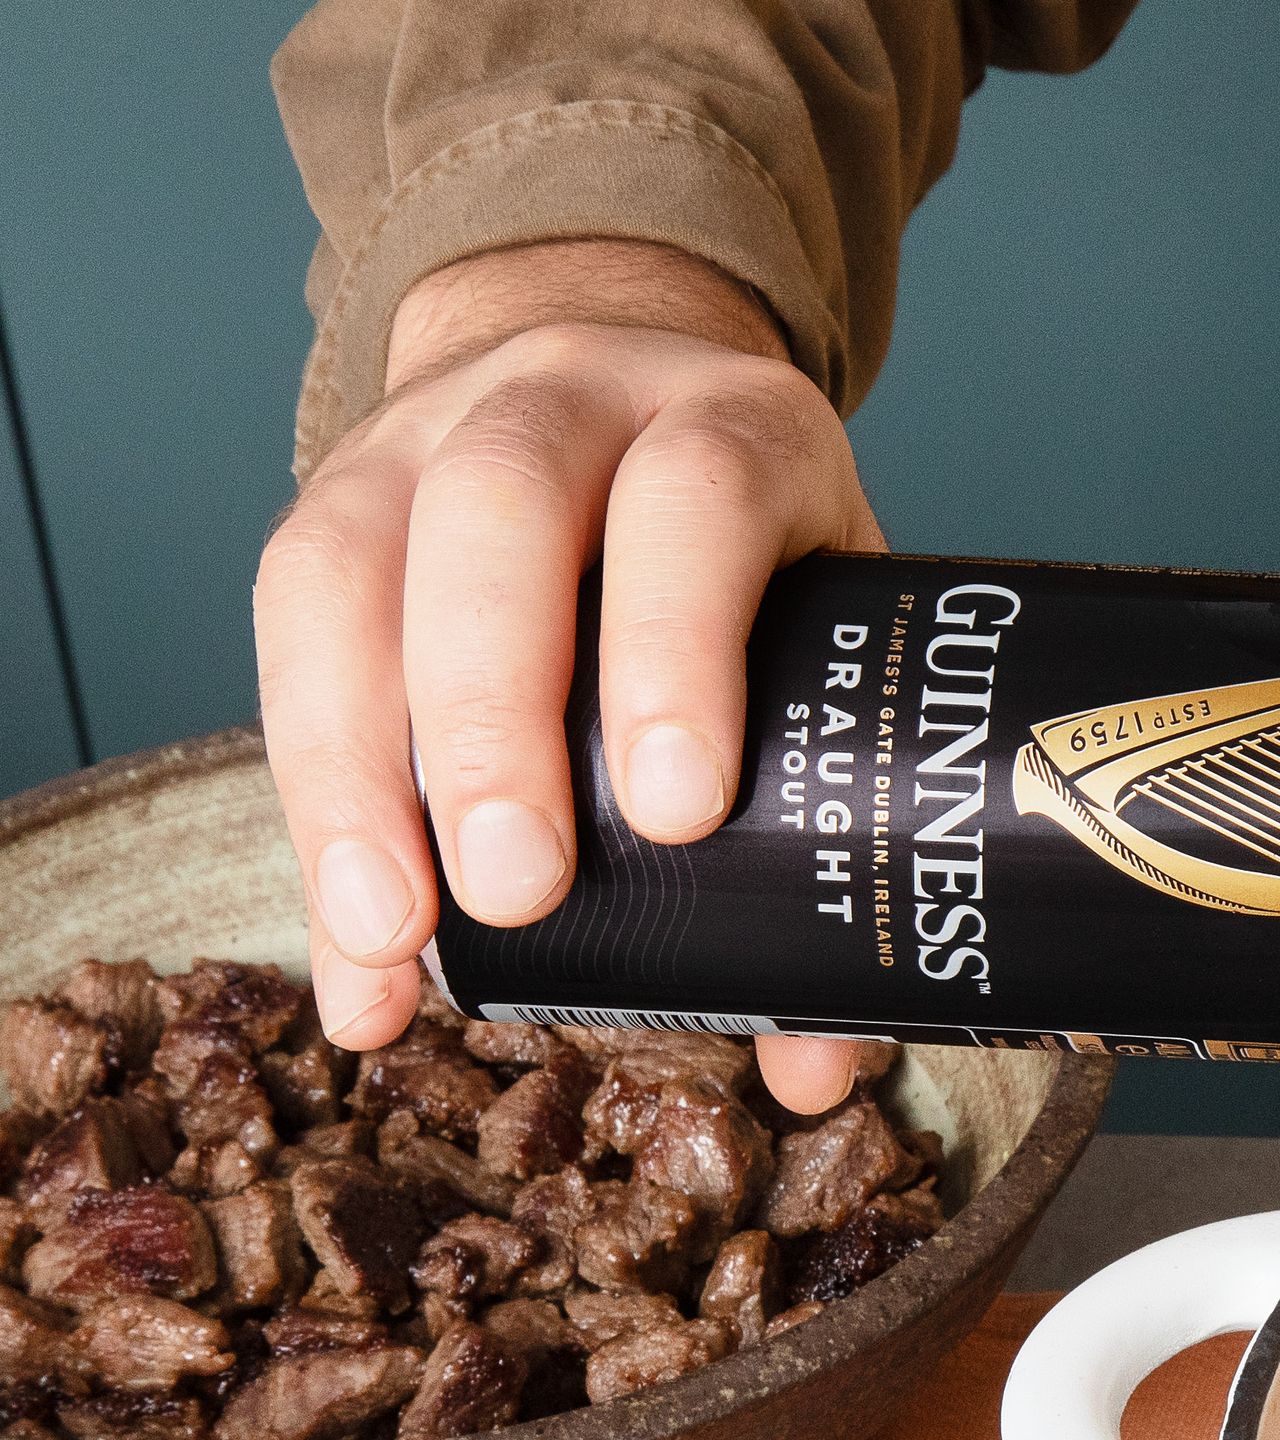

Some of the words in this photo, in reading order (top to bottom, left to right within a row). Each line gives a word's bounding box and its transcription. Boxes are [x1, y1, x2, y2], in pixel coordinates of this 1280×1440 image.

[897, 593, 915, 611] ST
[882, 617, 908, 696] JAMES'S
[780, 702, 811, 829] STOUT
[815, 623, 869, 923] DRAUGHT
[876, 707, 896, 764] GATE
[1070, 711, 1144, 753] 1759
[871, 775, 892, 871] DUBLIN,
[914, 583, 1022, 981] GUINNESS
[873, 879, 895, 967] IRELAND
